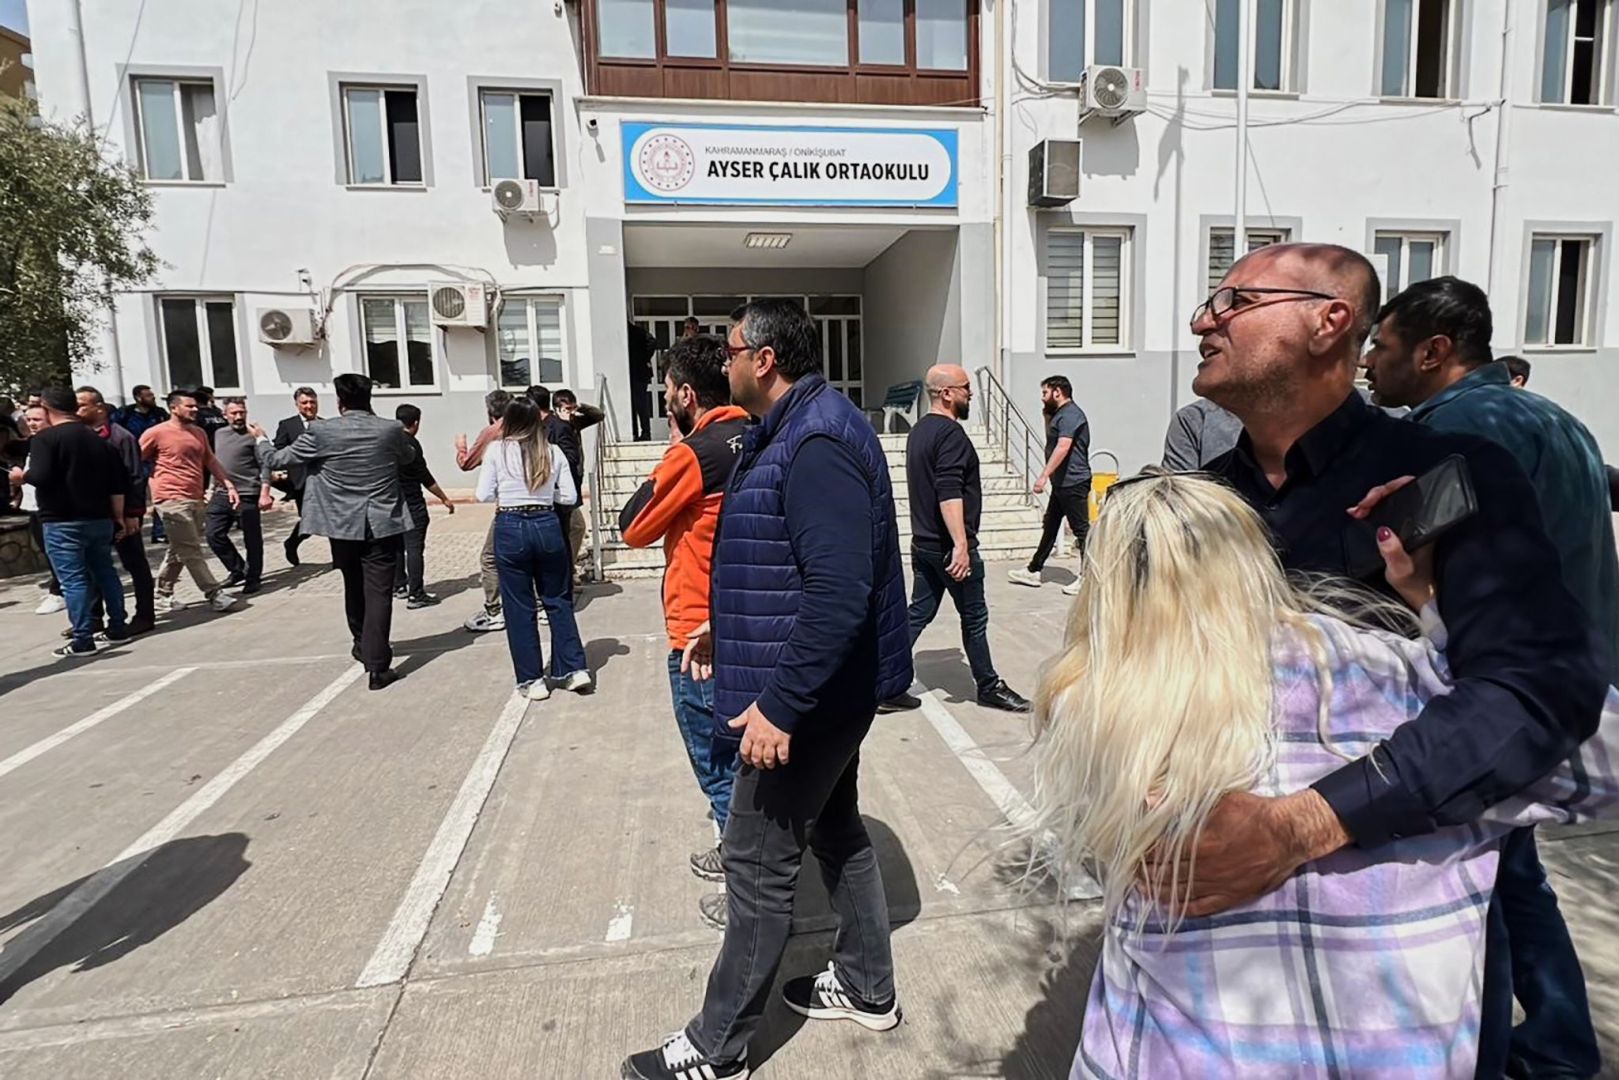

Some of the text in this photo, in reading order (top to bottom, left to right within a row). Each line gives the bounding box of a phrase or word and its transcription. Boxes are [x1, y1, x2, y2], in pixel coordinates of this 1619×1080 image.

[705, 145, 787, 158] KAHRAMANMARAŞ
[707, 160, 929, 181] AYSER ÇALIK ORTAOKULU
